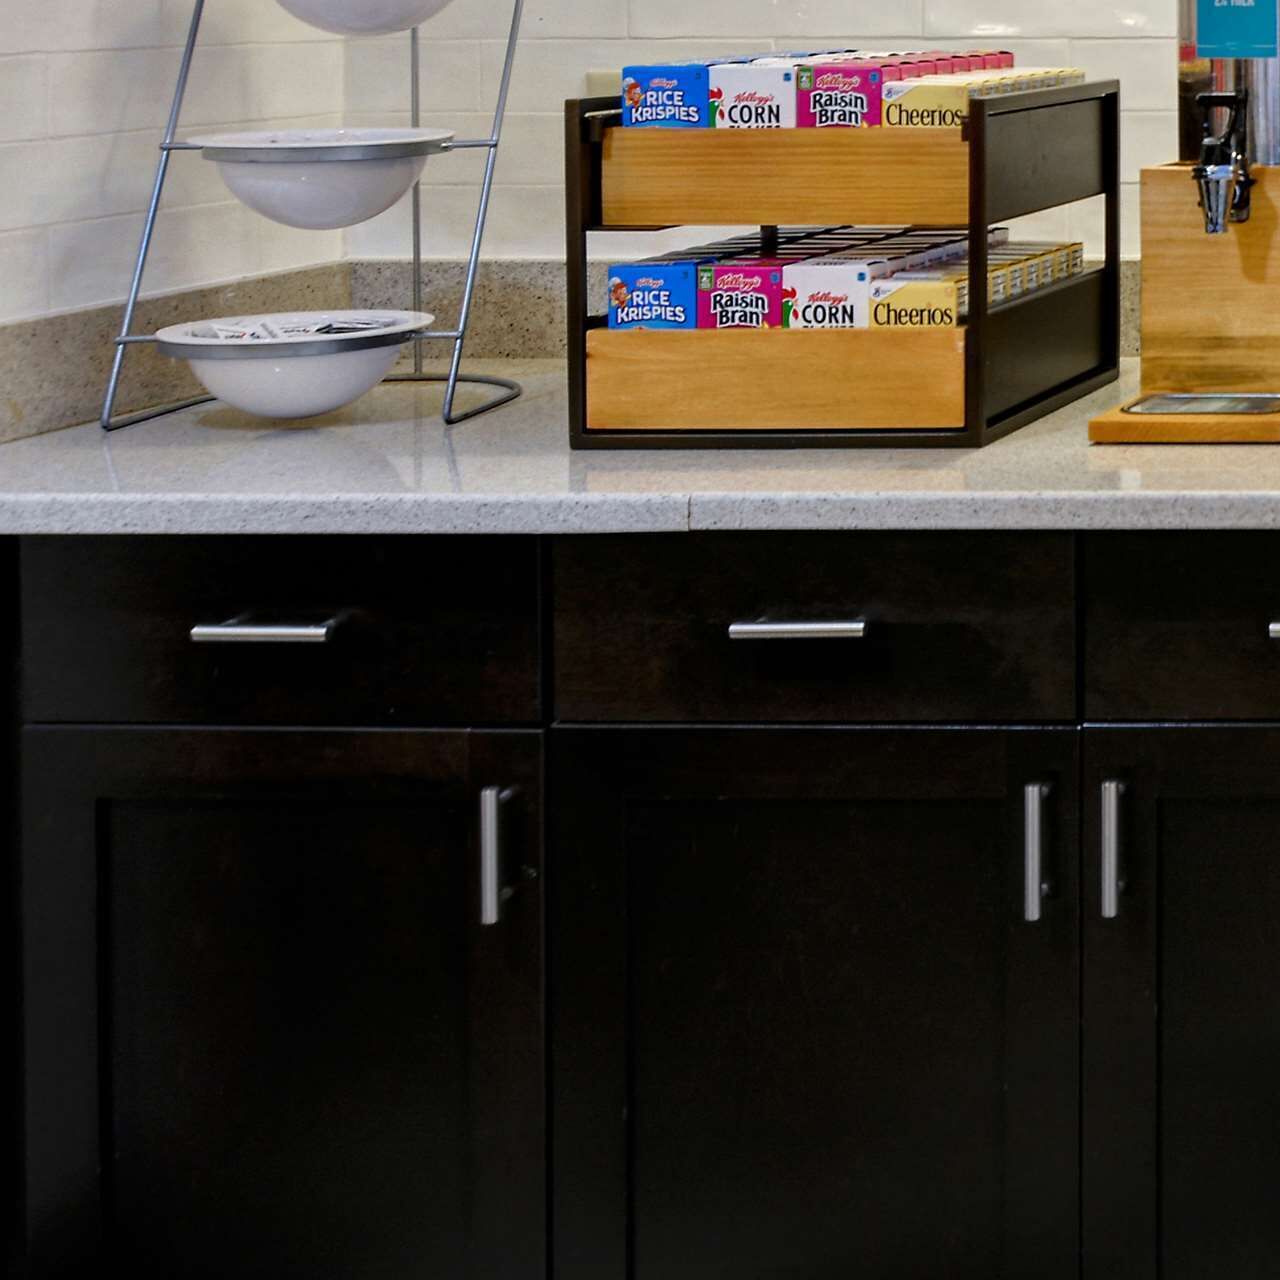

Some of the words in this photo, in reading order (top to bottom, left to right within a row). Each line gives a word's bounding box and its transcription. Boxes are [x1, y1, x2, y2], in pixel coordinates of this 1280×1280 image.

[817, 73, 859, 90] Kellogg's
[646, 91, 683, 105] RICE
[734, 92, 775, 105] Kellogg's
[811, 92, 865, 110] Raisin
[631, 107, 699, 123] KRISPIES
[728, 105, 780, 124] CORN
[818, 109, 859, 125] Bran
[886, 104, 962, 126] Cheerios
[717, 273, 761, 291] Kellogg's
[633, 291, 670, 305] RICE
[712, 293, 766, 310] Raisin
[808, 291, 848, 305] Kellogg's
[617, 307, 685, 323] KRISPIES
[719, 309, 760, 325] Bran
[802, 305, 854, 324] CORN
[874, 303, 953, 326] Cheerios
